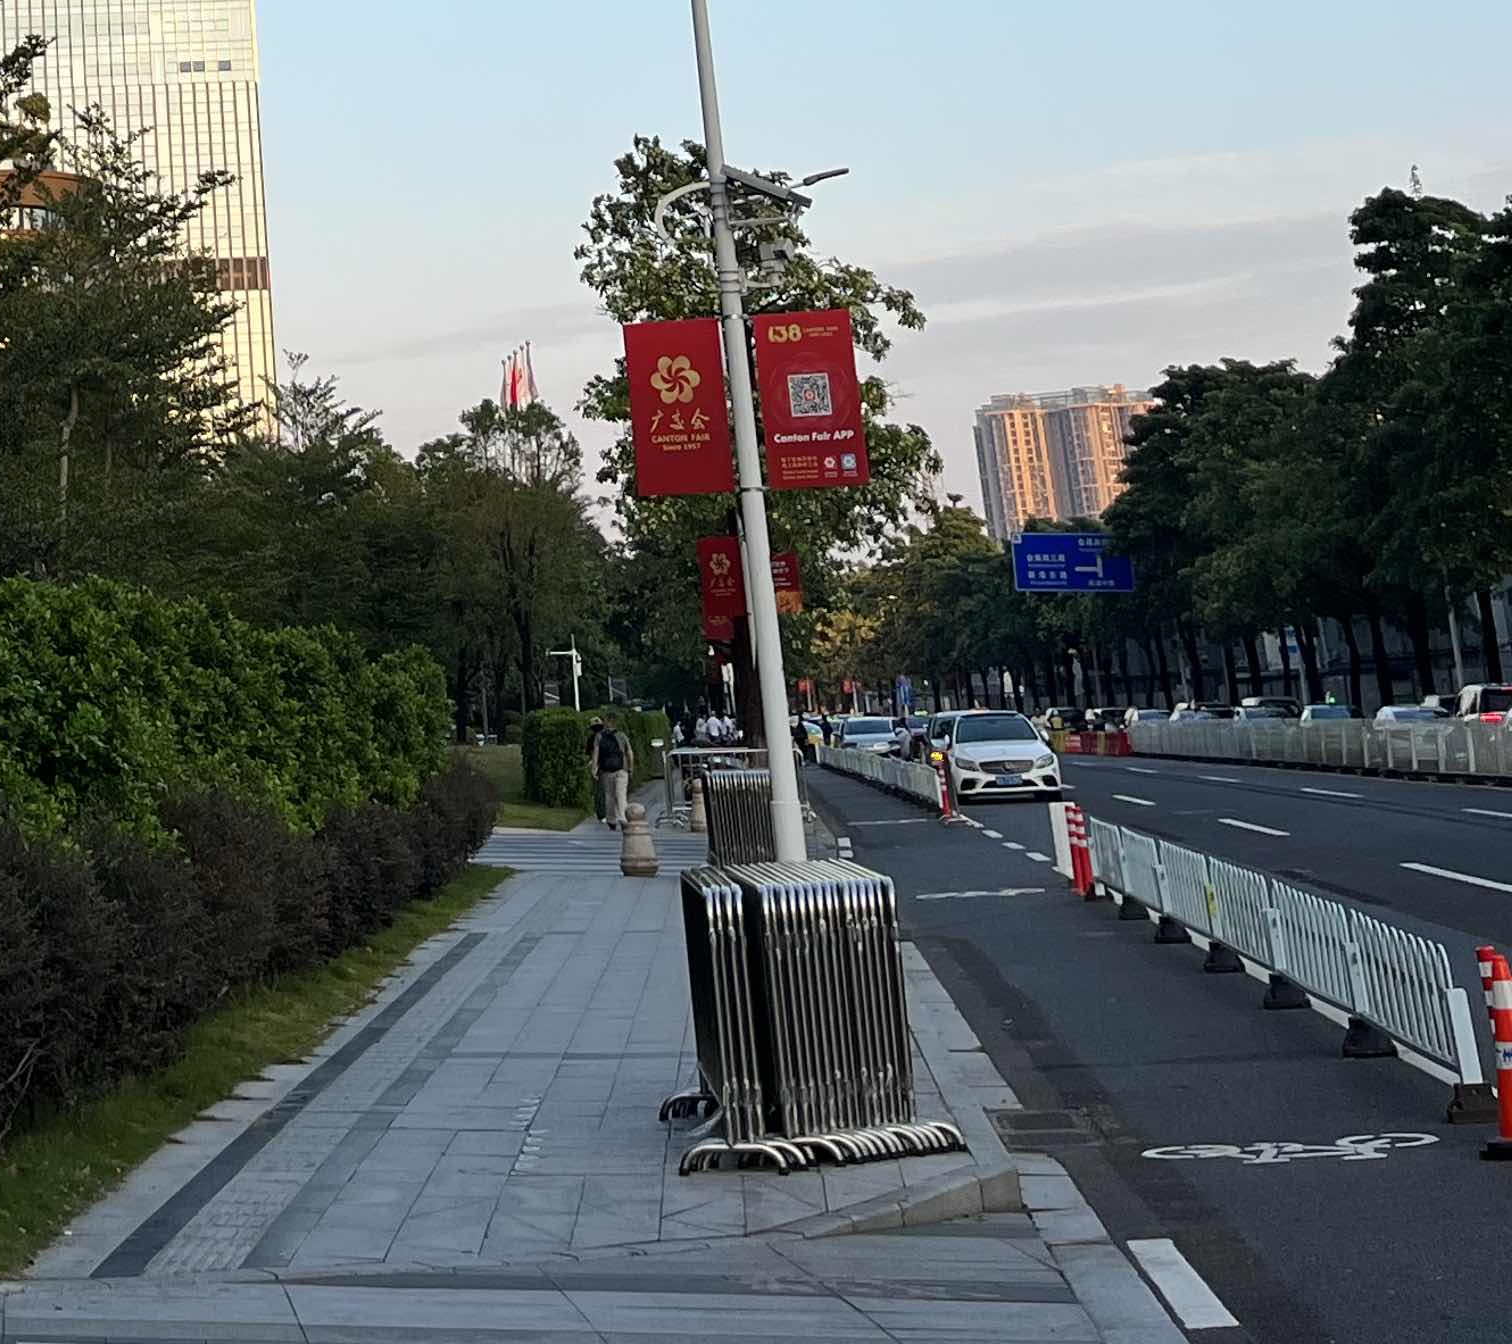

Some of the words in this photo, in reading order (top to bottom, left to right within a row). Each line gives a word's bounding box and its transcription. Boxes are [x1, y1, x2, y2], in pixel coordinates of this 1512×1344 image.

[650, 407, 711, 433] 广交会
[774, 433, 809, 443] Canton
[811, 431, 832, 441] Fair
[833, 430, 854, 440] APP
